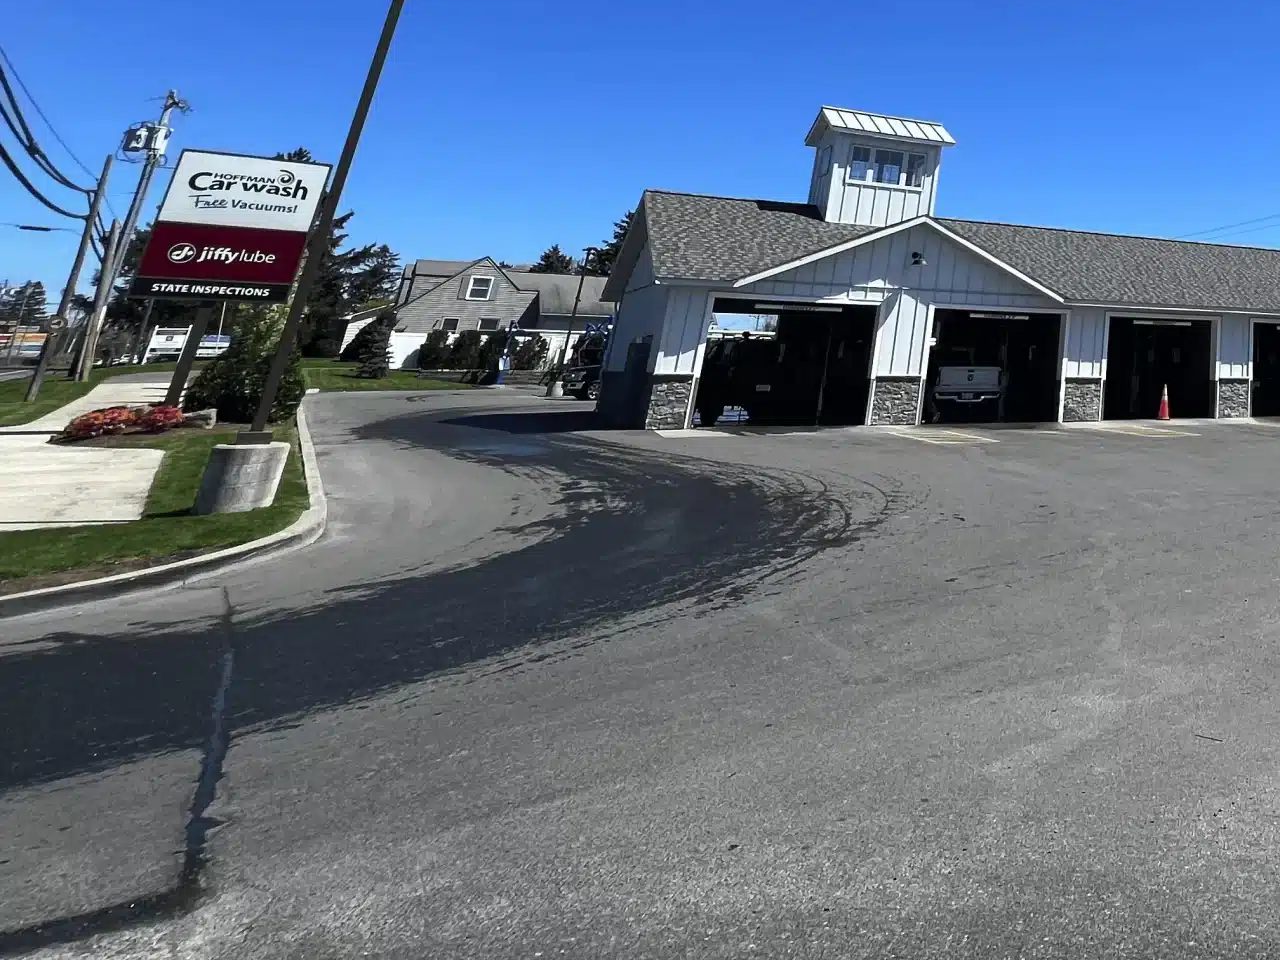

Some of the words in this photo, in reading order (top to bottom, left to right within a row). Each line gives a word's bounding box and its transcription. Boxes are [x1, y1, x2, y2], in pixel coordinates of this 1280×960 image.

[188, 171, 238, 191] Car
[242, 179, 308, 200] wash
[213, 172, 276, 184] HOFFMAN
[188, 194, 229, 209] Free
[231, 199, 298, 213] Vacuums!
[151, 283, 189, 293] STATE
[190, 285, 270, 297] INSPECTIONS
